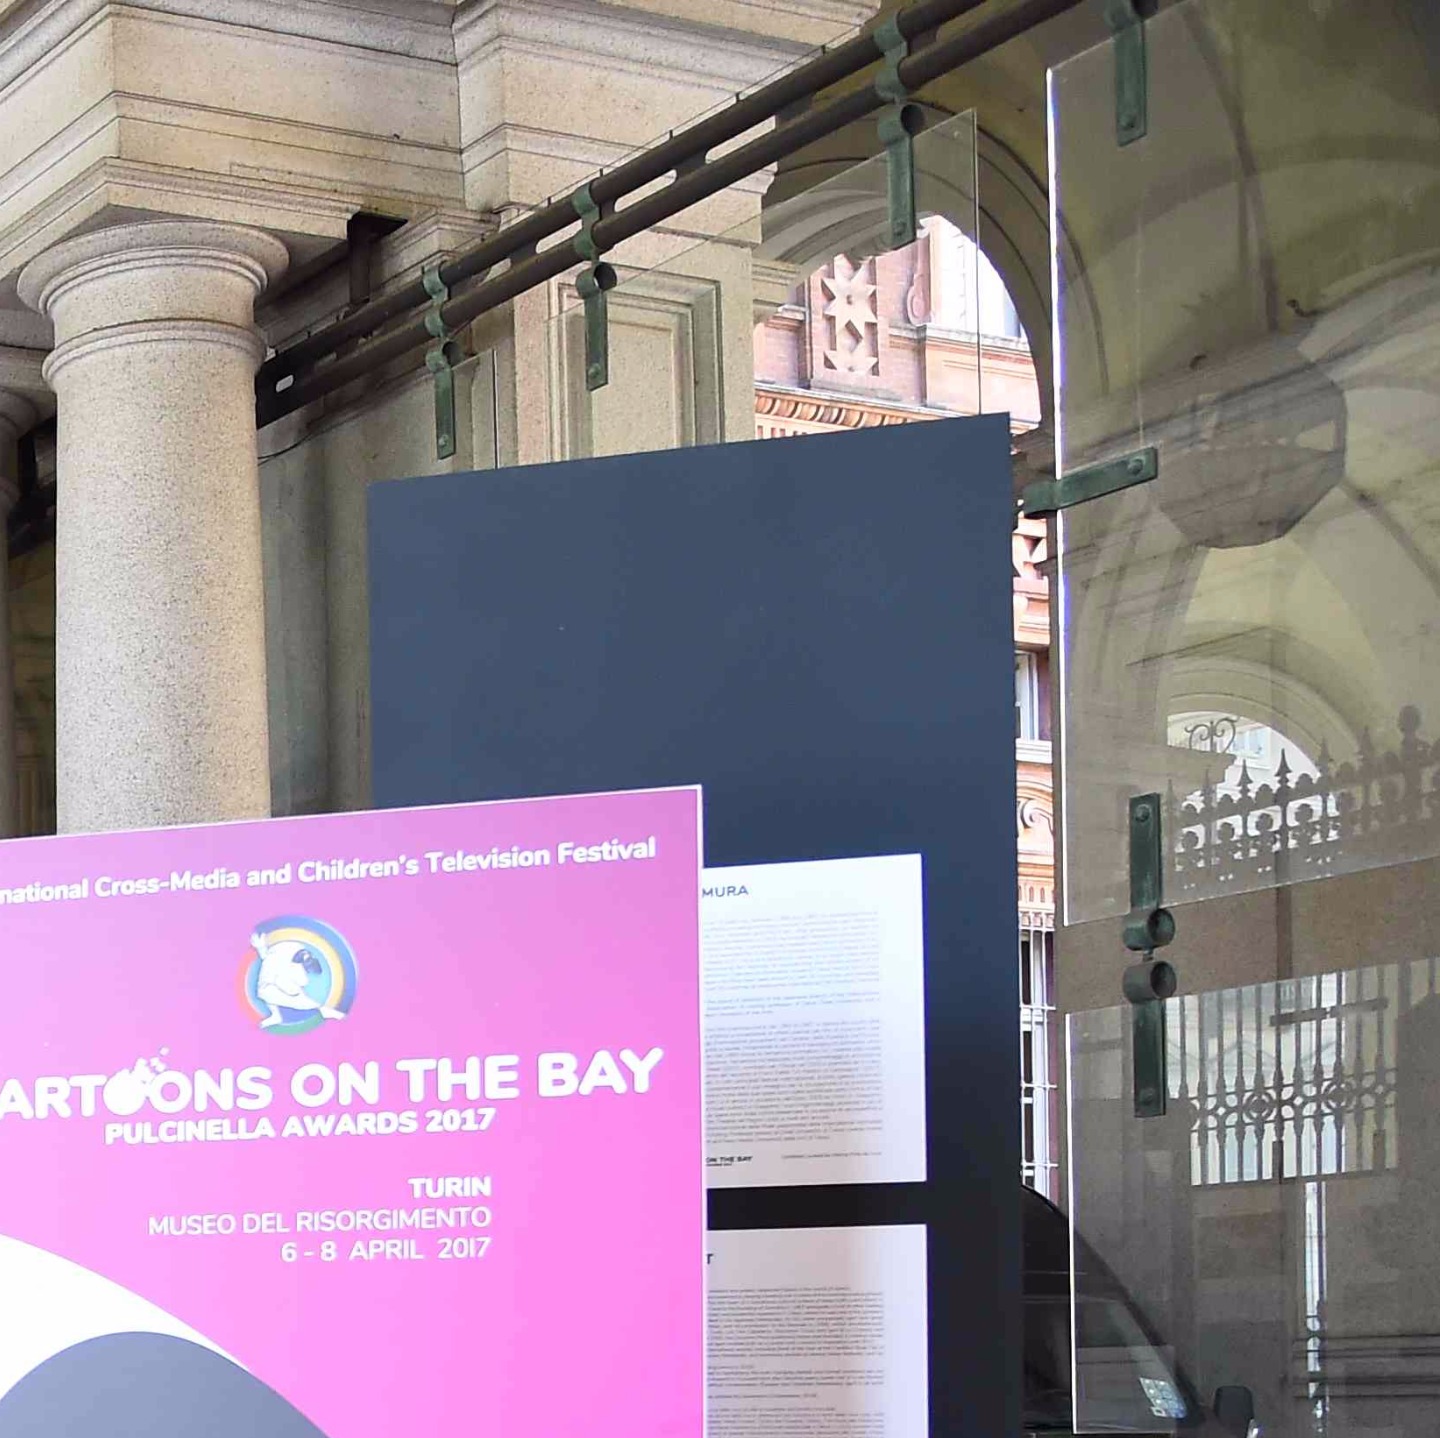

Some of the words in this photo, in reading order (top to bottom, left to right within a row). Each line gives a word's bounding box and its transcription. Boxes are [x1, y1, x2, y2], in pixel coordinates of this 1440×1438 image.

[94, 867, 240, 898] Cross-Media
[246, 862, 292, 887] and
[298, 855, 420, 884] Children's
[424, 845, 551, 874] Television
[558, 836, 656, 865] Festival
[290, 1060, 380, 1108] ON
[395, 1054, 520, 1103] THE
[536, 1047, 665, 1098] BAY
[104, 1117, 277, 1146] PULCINELLA
[281, 1110, 419, 1138] AWARDS
[424, 1107, 497, 1134] 2017
[407, 1176, 492, 1200] TURIN
[147, 1212, 237, 1236] MUSEO
[241, 1211, 291, 1234] DEL
[295, 1206, 492, 1233] RISORGIMENTO
[280, 1242, 298, 1263] 6
[319, 1240, 338, 1262] 8
[348, 1238, 425, 1261] APRIL
[437, 1236, 492, 1259] 2017
